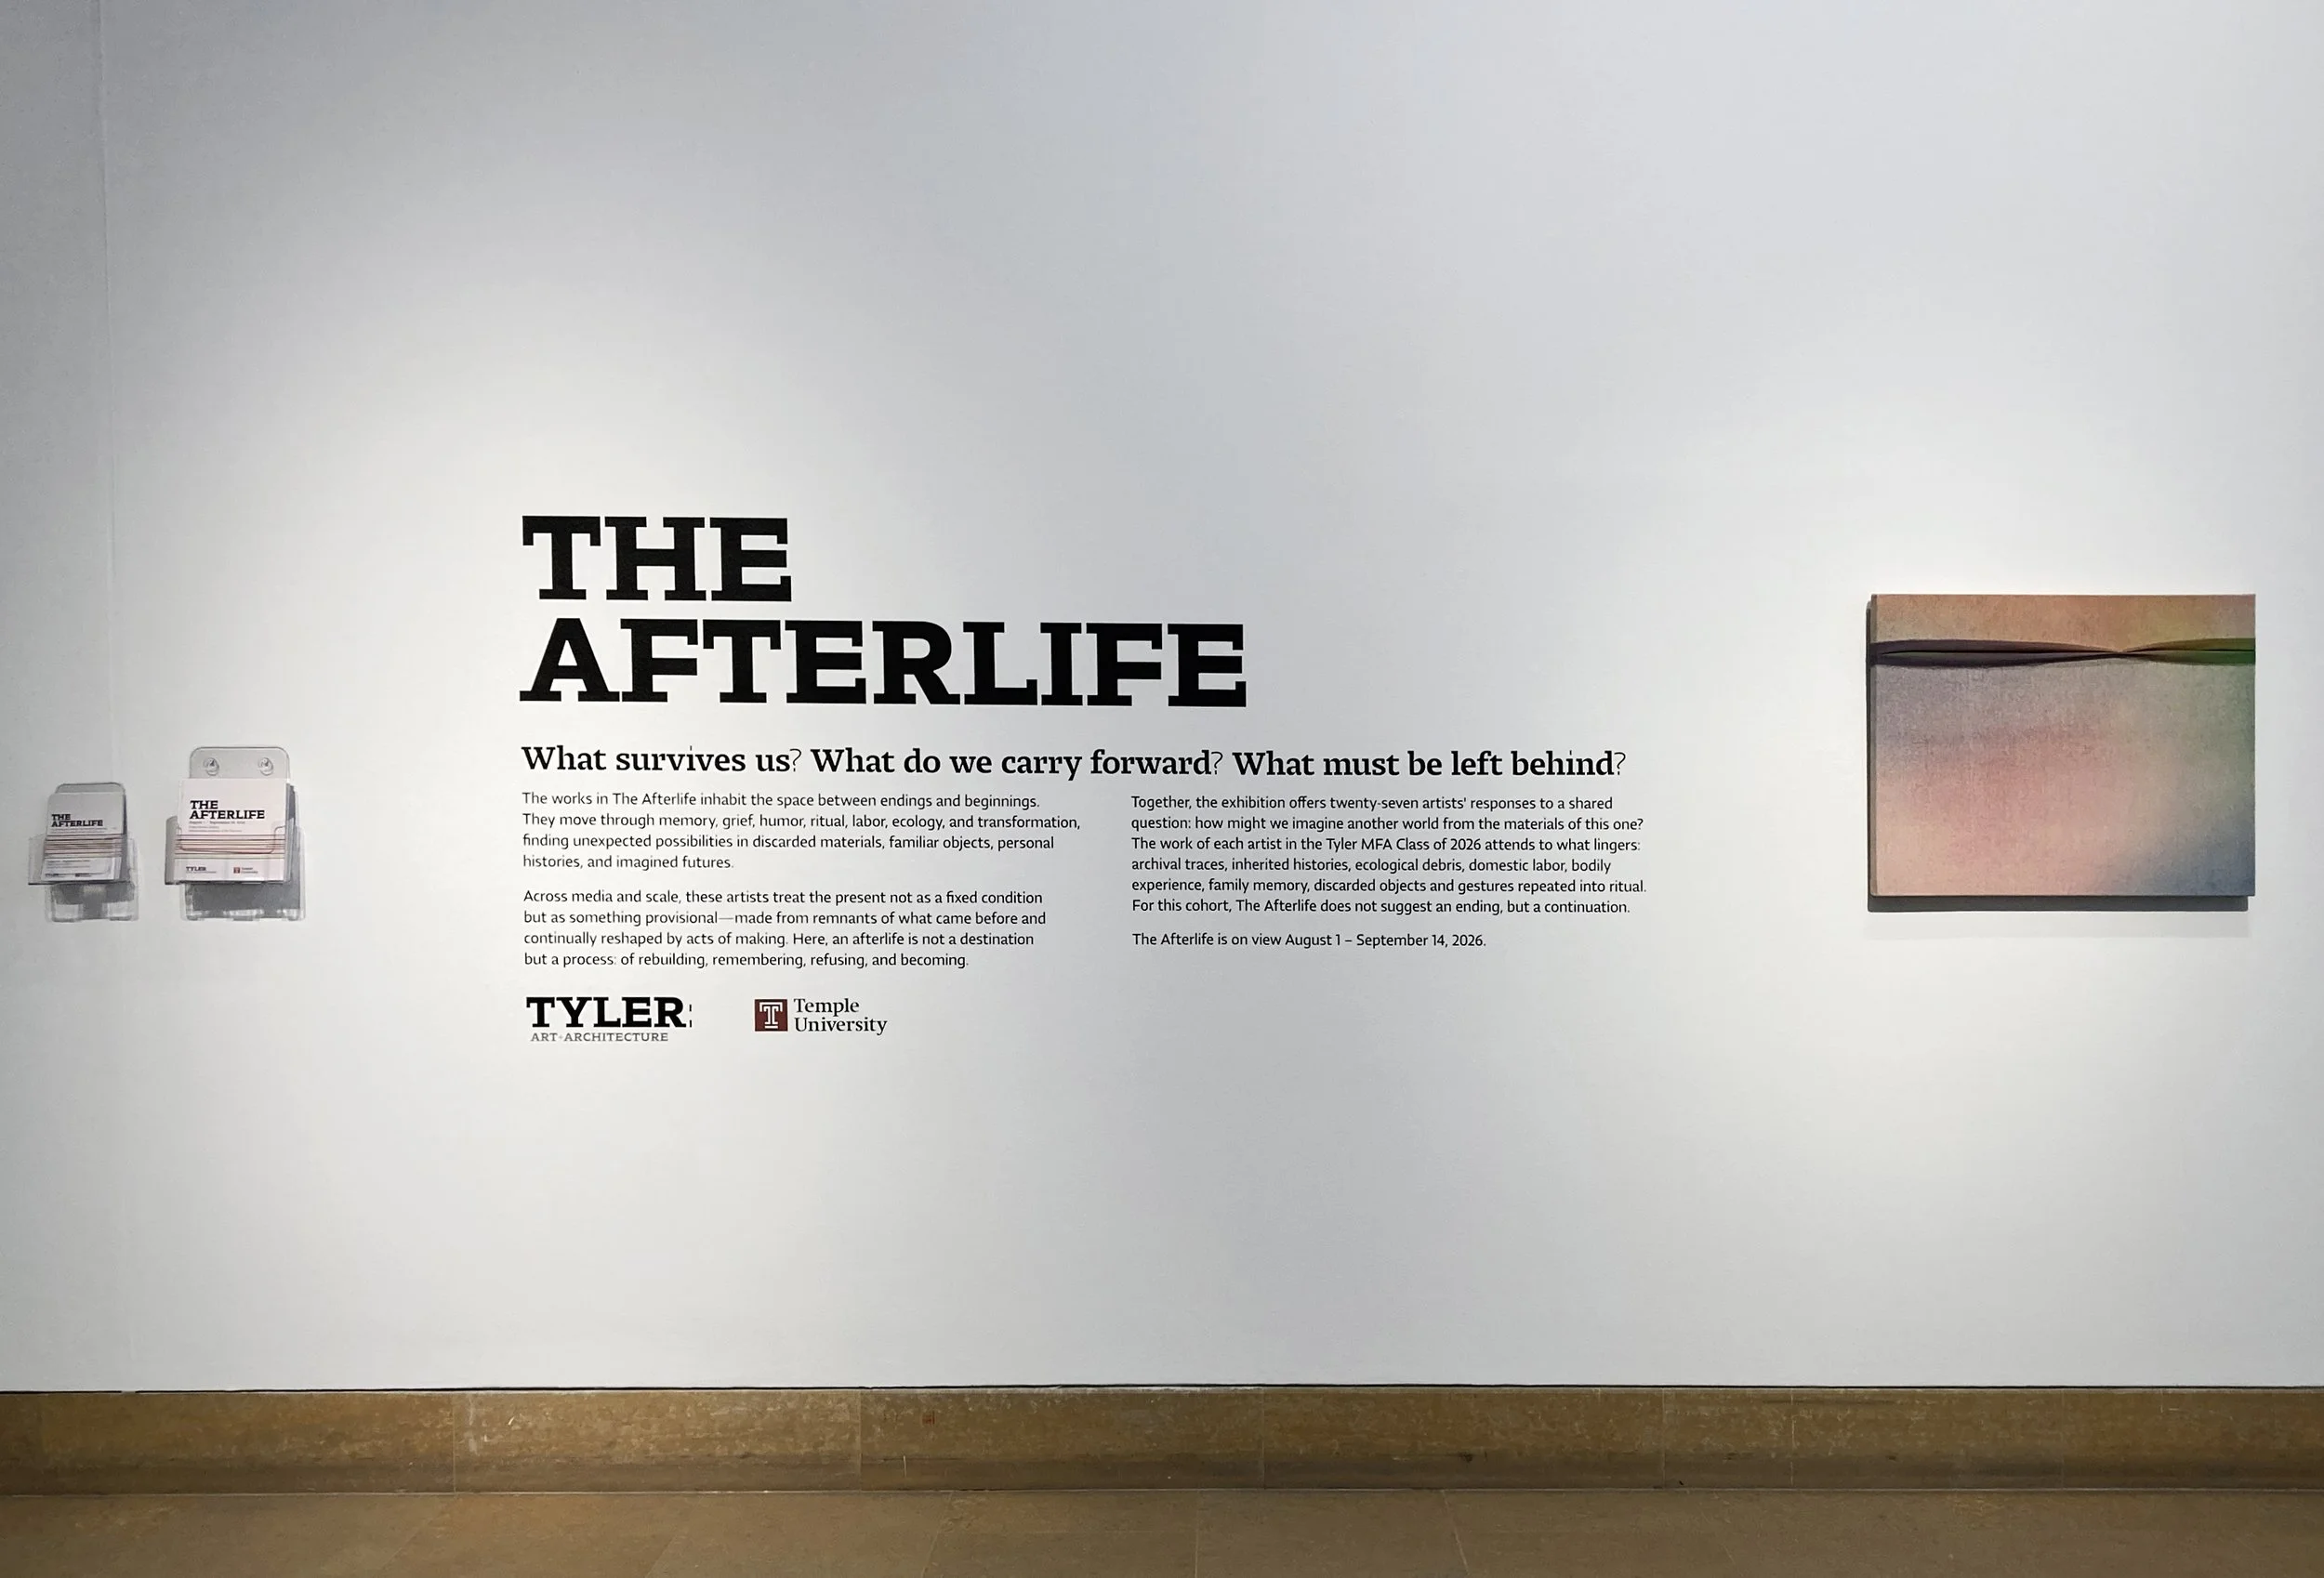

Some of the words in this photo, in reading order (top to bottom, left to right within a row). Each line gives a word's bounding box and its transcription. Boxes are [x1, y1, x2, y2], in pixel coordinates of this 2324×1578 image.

[522, 516, 792, 602] THE
[520, 617, 1247, 707] AFTERLIFE
[521, 744, 607, 770] What
[615, 745, 746, 772] survives
[755, 748, 802, 772] us?
[810, 747, 895, 773] What
[904, 747, 941, 773] do
[949, 756, 993, 774] we
[1001, 756, 1083, 782] carry
[1089, 748, 1223, 775] forward?
[1232, 750, 1315, 776] What
[1323, 755, 1400, 776] must
[1406, 750, 1443, 776] be
[1450, 750, 1503, 776] left
[1511, 750, 1626, 776] behind?
[190, 800, 218, 809] THE
[522, 791, 548, 804] The
[551, 792, 593, 805] works
[597, 792, 608, 805] in
[612, 792, 638, 805] The
[641, 792, 696, 806] Afterlife
[701, 793, 747, 806] inhabit
[750, 793, 773, 806] the
[776, 796, 814, 809] space
[818, 793, 877, 807] between
[880, 794, 932, 810] endings
[936, 794, 960, 807] and
[965, 794, 1039, 811] beginnings.
[1130, 795, 1192, 811] Together,
[1195, 796, 1218, 809] the
[1221, 796, 1286, 809] exhibition
[1289, 796, 1327, 809] offers
[1329, 797, 1419, 812] twenty-seven
[1471, 799, 1537, 812] responses
[1539, 797, 1553, 809] to
[1557, 800, 1565, 809] a
[1568, 796, 1613, 809] shared
[51, 819, 103, 827] AFTERLIFE
[189, 810, 265, 819] AFTERLIFE
[1131, 816, 1191, 832] question:
[1195, 816, 1223, 829] how
[1227, 816, 1266, 833] might
[1270, 820, 1288, 829] we
[1292, 816, 1344, 833] imagine
[1347, 817, 1399, 830] another
[1402, 817, 1439, 830] world
[1443, 817, 1474, 830] from
[1478, 817, 1500, 830] the
[1504, 817, 1565, 830] materials
[1567, 817, 1582, 830] of
[1585, 817, 1609, 830] this
[1613, 818, 1644, 831] one?
[1131, 836, 1156, 849] The
[1159, 836, 1193, 849] work
[1196, 836, 1211, 849] of
[1213, 836, 1244, 849] each
[1248, 836, 1282, 850] artist
[1286, 837, 1297, 849] in
[1301, 836, 1323, 850] the
[1326, 836, 1357, 853] Tyler
[1361, 838, 1393, 850] MFA
[1396, 836, 1430, 850] Class
[1433, 837, 1447, 850] of
[1450, 838, 1482, 850] 2026
[1485, 837, 1536, 851] attends
[1538, 839, 1553, 850] to
[1556, 837, 1591, 851] what
[1594, 837, 1641, 854] lingers:
[523, 854, 583, 869] histories,
[588, 855, 612, 868] and
[616, 855, 678, 872] imagined
[682, 855, 733, 869] futures.
[1131, 877, 1205, 894] experience,
[1208, 877, 1249, 894] family
[1253, 881, 1310, 895] memory,
[1314, 878, 1376, 891] discarded
[1380, 878, 1427, 895] objects
[1430, 878, 1454, 892] and
[1458, 880, 1514, 895] gestures
[1518, 879, 1576, 895] repeated
[1579, 879, 1605, 892] into
[1609, 879, 1646, 892] ritual.
[523, 889, 568, 902] Across
[572, 889, 614, 902] media
[616, 889, 641, 902] and
[645, 889, 681, 904] scale,
[685, 889, 723, 903] these
[726, 890, 770, 903] artists
[772, 891, 806, 903] treat
[809, 890, 831, 903] the
[836, 892, 886, 906] present
[890, 892, 913, 903] not
[917, 894, 931, 903] as
[934, 894, 943, 903] a
[945, 890, 978, 904] fixed
[981, 890, 1042, 904] condition
[1132, 899, 1155, 912] For
[1157, 898, 1182, 912] this
[1185, 898, 1232, 913] cohort,
[1235, 899, 1261, 912] The
[1263, 899, 1317, 912] Afterlife
[1320, 899, 1352, 913] does
[1354, 901, 1378, 912] not
[1380, 901, 1433, 915] suggest
[1435, 902, 1452, 913] an
[1456, 900, 1503, 916] ending,
[1507, 900, 1530, 913] but
[1533, 903, 1541, 913] a
[1544, 900, 1630, 914] continuation.
[524, 931, 597, 947] continually
[601, 931, 663, 948] reshaped
[667, 931, 682, 948] by
[686, 933, 714, 945] acts
[718, 931, 733, 944] of
[735, 932, 788, 948] making.
[793, 933, 828, 946] Here,
[832, 935, 849, 945] an
[852, 931, 905, 945] afterlife
[908, 932, 918, 945] is
[922, 934, 945, 945] not
[948, 935, 957, 945] a
[959, 932, 1034, 945] destination
[1131, 932, 1157, 945] The
[1160, 932, 1214, 945] Afterlife
[1218, 932, 1228, 945] is
[1231, 936, 1248, 945] on
[1251, 933, 1282, 946] view
[1285, 934, 1332, 949] August
[1335, 934, 1340, 946] 1
[1356, 933, 1429, 949] September
[1432, 934, 1448, 948] 14,
[1452, 934, 1486, 947] 2026.
[524, 952, 548, 966] but
[551, 955, 560, 966] a
[563, 955, 616, 968] process:
[620, 952, 635, 966] of
[639, 953, 708, 969] rebuilding,
[712, 953, 806, 969] remembering,
[811, 953, 868, 969] refusing,
[872, 953, 896, 966] and
[901, 953, 969, 969] becoming.
[526, 996, 687, 1028] TYLER
[794, 998, 860, 1017] Temple
[795, 1017, 888, 1036] University
